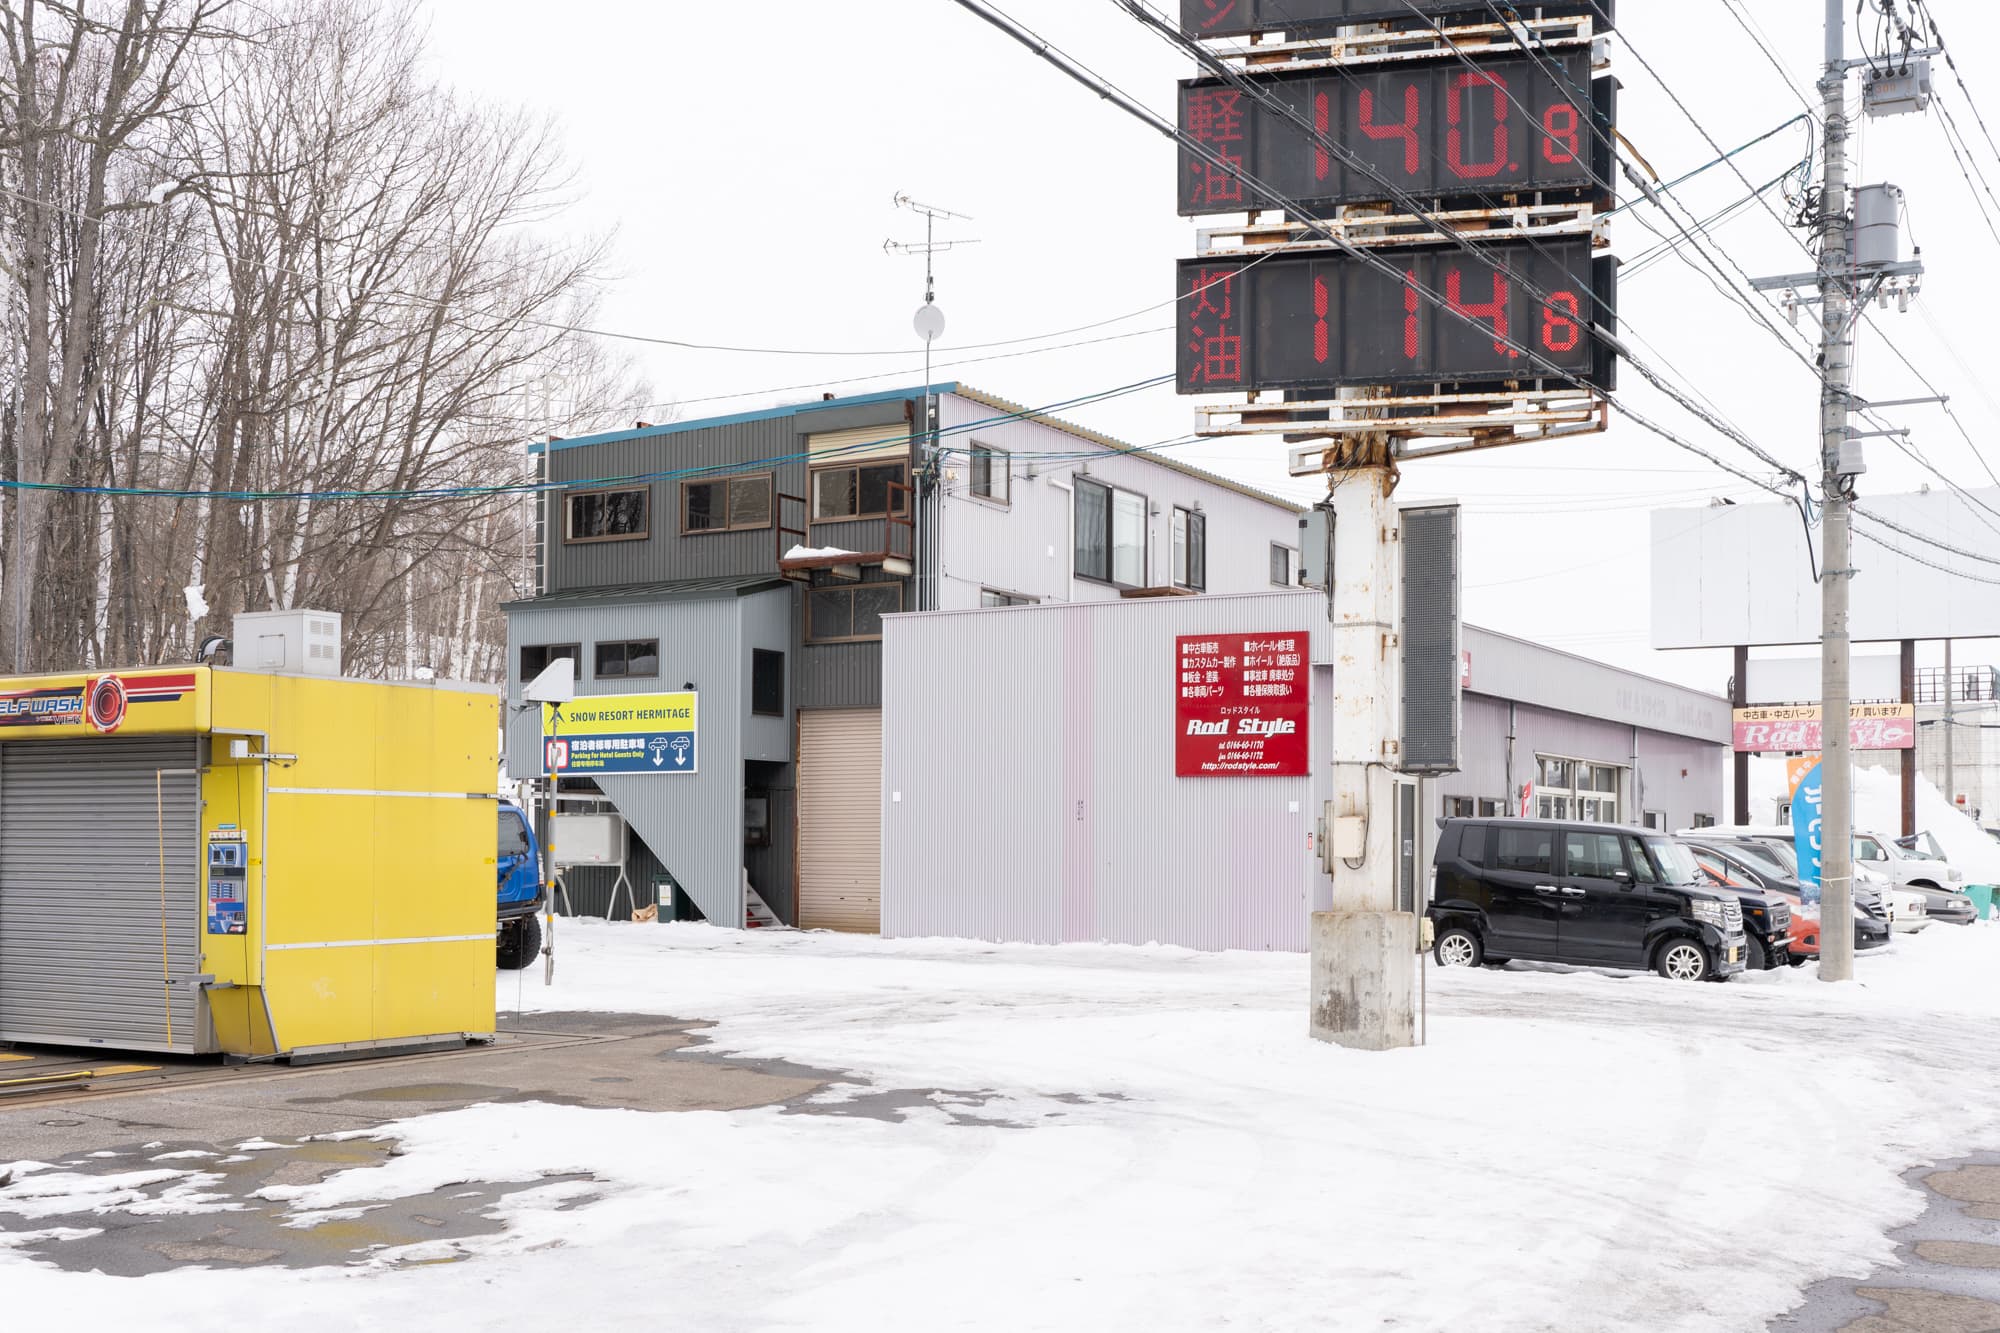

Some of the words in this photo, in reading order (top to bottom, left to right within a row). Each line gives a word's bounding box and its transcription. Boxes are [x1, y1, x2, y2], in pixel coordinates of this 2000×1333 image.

[1188, 90, 1243, 204] 軽油
[1189, 268, 1241, 383] 灯油
[1188, 641, 1219, 654] 中古車販売
[1249, 639, 1295, 652] ホイール修理
[1188, 656, 1237, 669] カスタムカー製作
[31, 696, 84, 714] WASH
[1220, 706, 1260, 715] ロッドスタイル
[570, 711, 596, 722] SNOW
[599, 710, 634, 721] RESORT
[637, 708, 690, 719] HERMITAGE
[1743, 709, 1816, 721] 中古車・中古パーツ
[1186, 718, 1230, 736] Rod
[1237, 718, 1296, 738] Style
[1744, 722, 1808, 746] Rod
[571, 752, 591, 762] Parking
[617, 751, 632, 759] Guests
[633, 751, 645, 759] Only
[1201, 761, 1280, 771] http://rodstyle.com/
